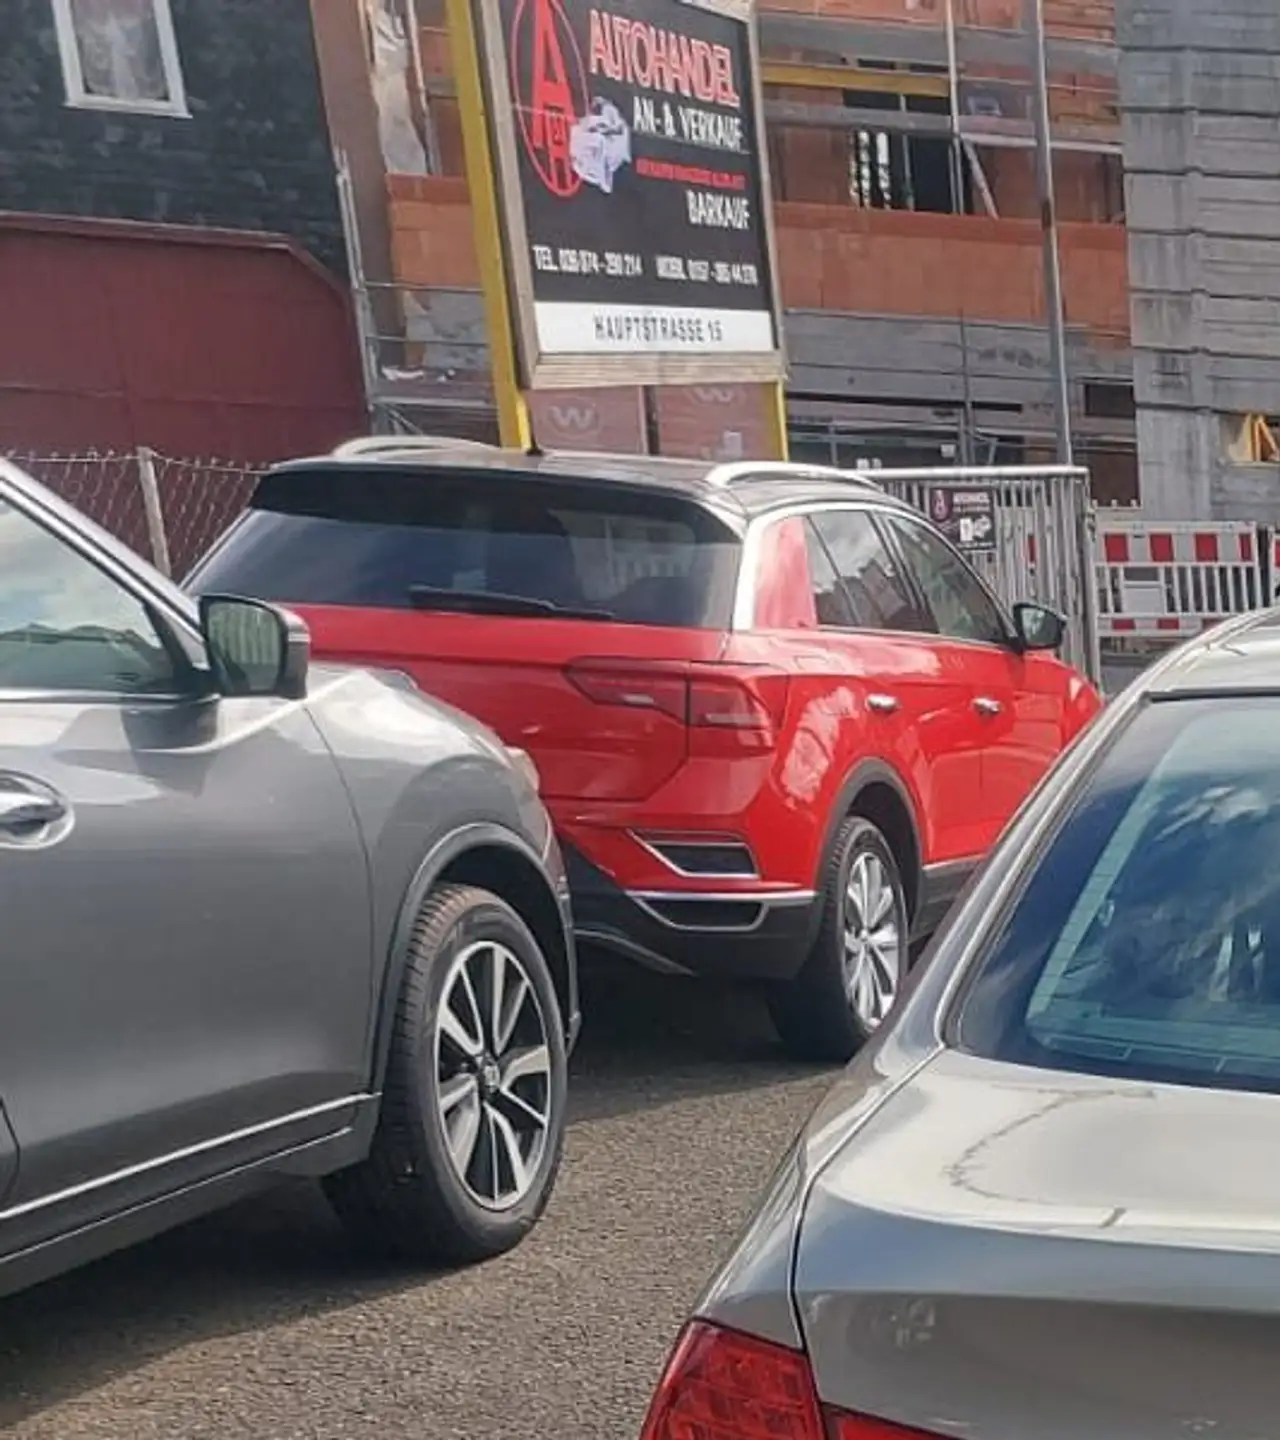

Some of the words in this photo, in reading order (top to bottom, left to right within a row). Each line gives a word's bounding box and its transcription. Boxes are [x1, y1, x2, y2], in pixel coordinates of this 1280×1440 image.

[590, 9, 740, 108] AUTOHANDEL
[678, 104, 741, 151] VERKAUF
[687, 189, 750, 230] BARKAUF
[594, 313, 705, 343] HAUPTSTRASSE
[707, 319, 723, 342] 15
